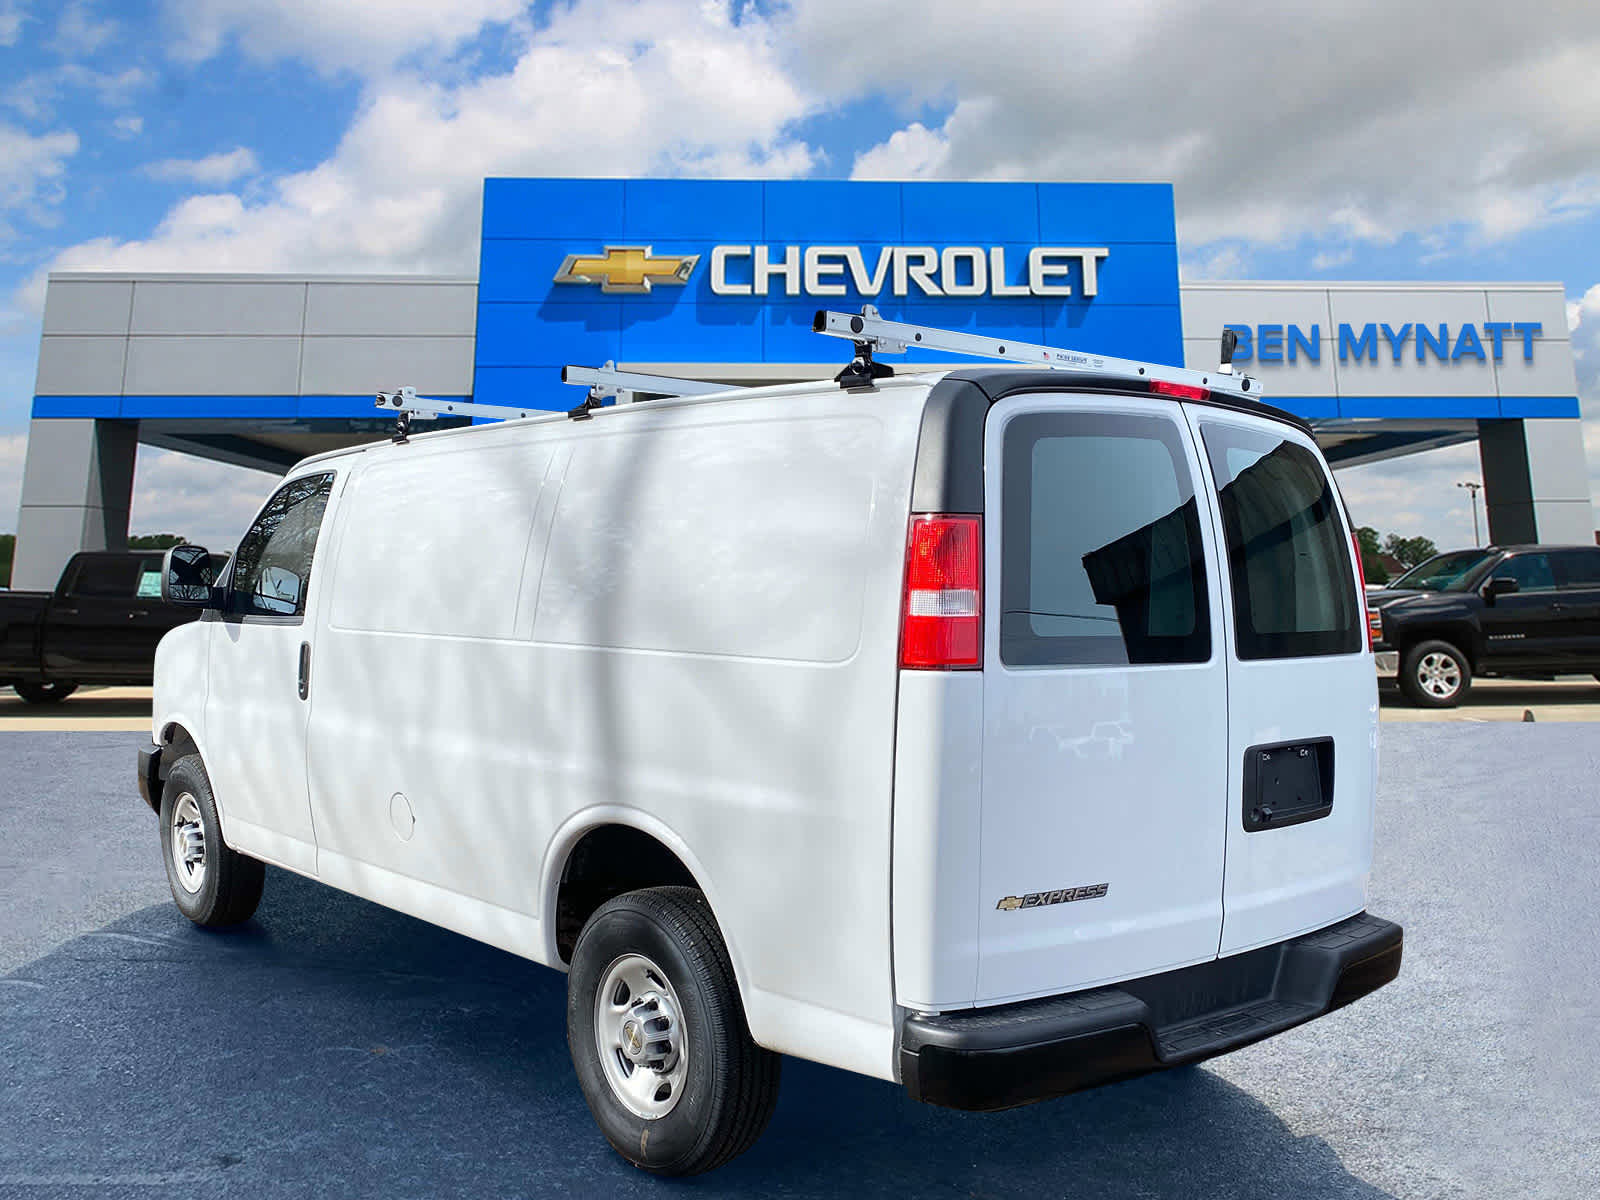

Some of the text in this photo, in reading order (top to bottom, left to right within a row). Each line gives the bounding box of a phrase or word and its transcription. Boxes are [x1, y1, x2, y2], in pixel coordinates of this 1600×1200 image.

[710, 244, 1110, 297] CHEVROLET
[1223, 322, 1543, 364] BEN MYNATT
[1022, 883, 1109, 909] EXPRESS
